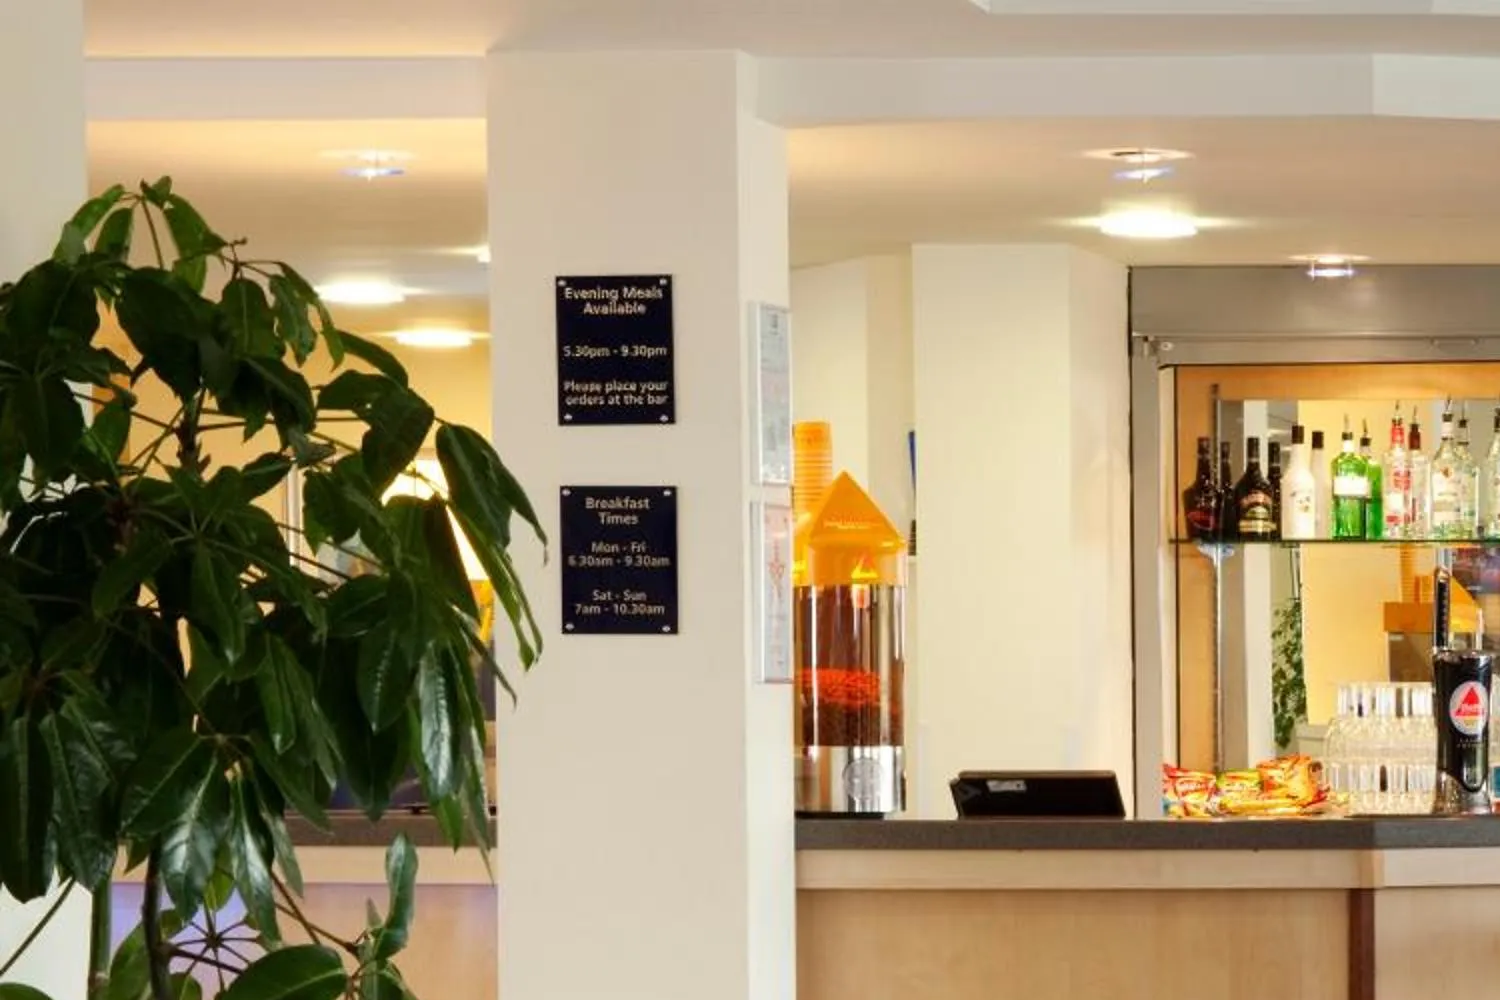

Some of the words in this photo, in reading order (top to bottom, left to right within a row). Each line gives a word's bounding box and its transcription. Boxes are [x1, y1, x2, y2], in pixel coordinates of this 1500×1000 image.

[565, 286, 619, 300] Evening
[622, 285, 663, 299] Meals
[583, 301, 646, 315] Available
[563, 379, 602, 393] Please
[605, 378, 637, 395] place
[640, 381, 668, 394] your
[565, 393, 605, 406] orders
[607, 394, 621, 406] at
[623, 394, 644, 406] the
[647, 394, 669, 406] bar
[585, 496, 650, 510] Breakfast
[598, 511, 639, 525] Times
[591, 541, 620, 553] Mon
[630, 540, 647, 553] Fri
[592, 589, 613, 601] Sat
[623, 589, 647, 601] Sun
[574, 603, 601, 615] 7am
